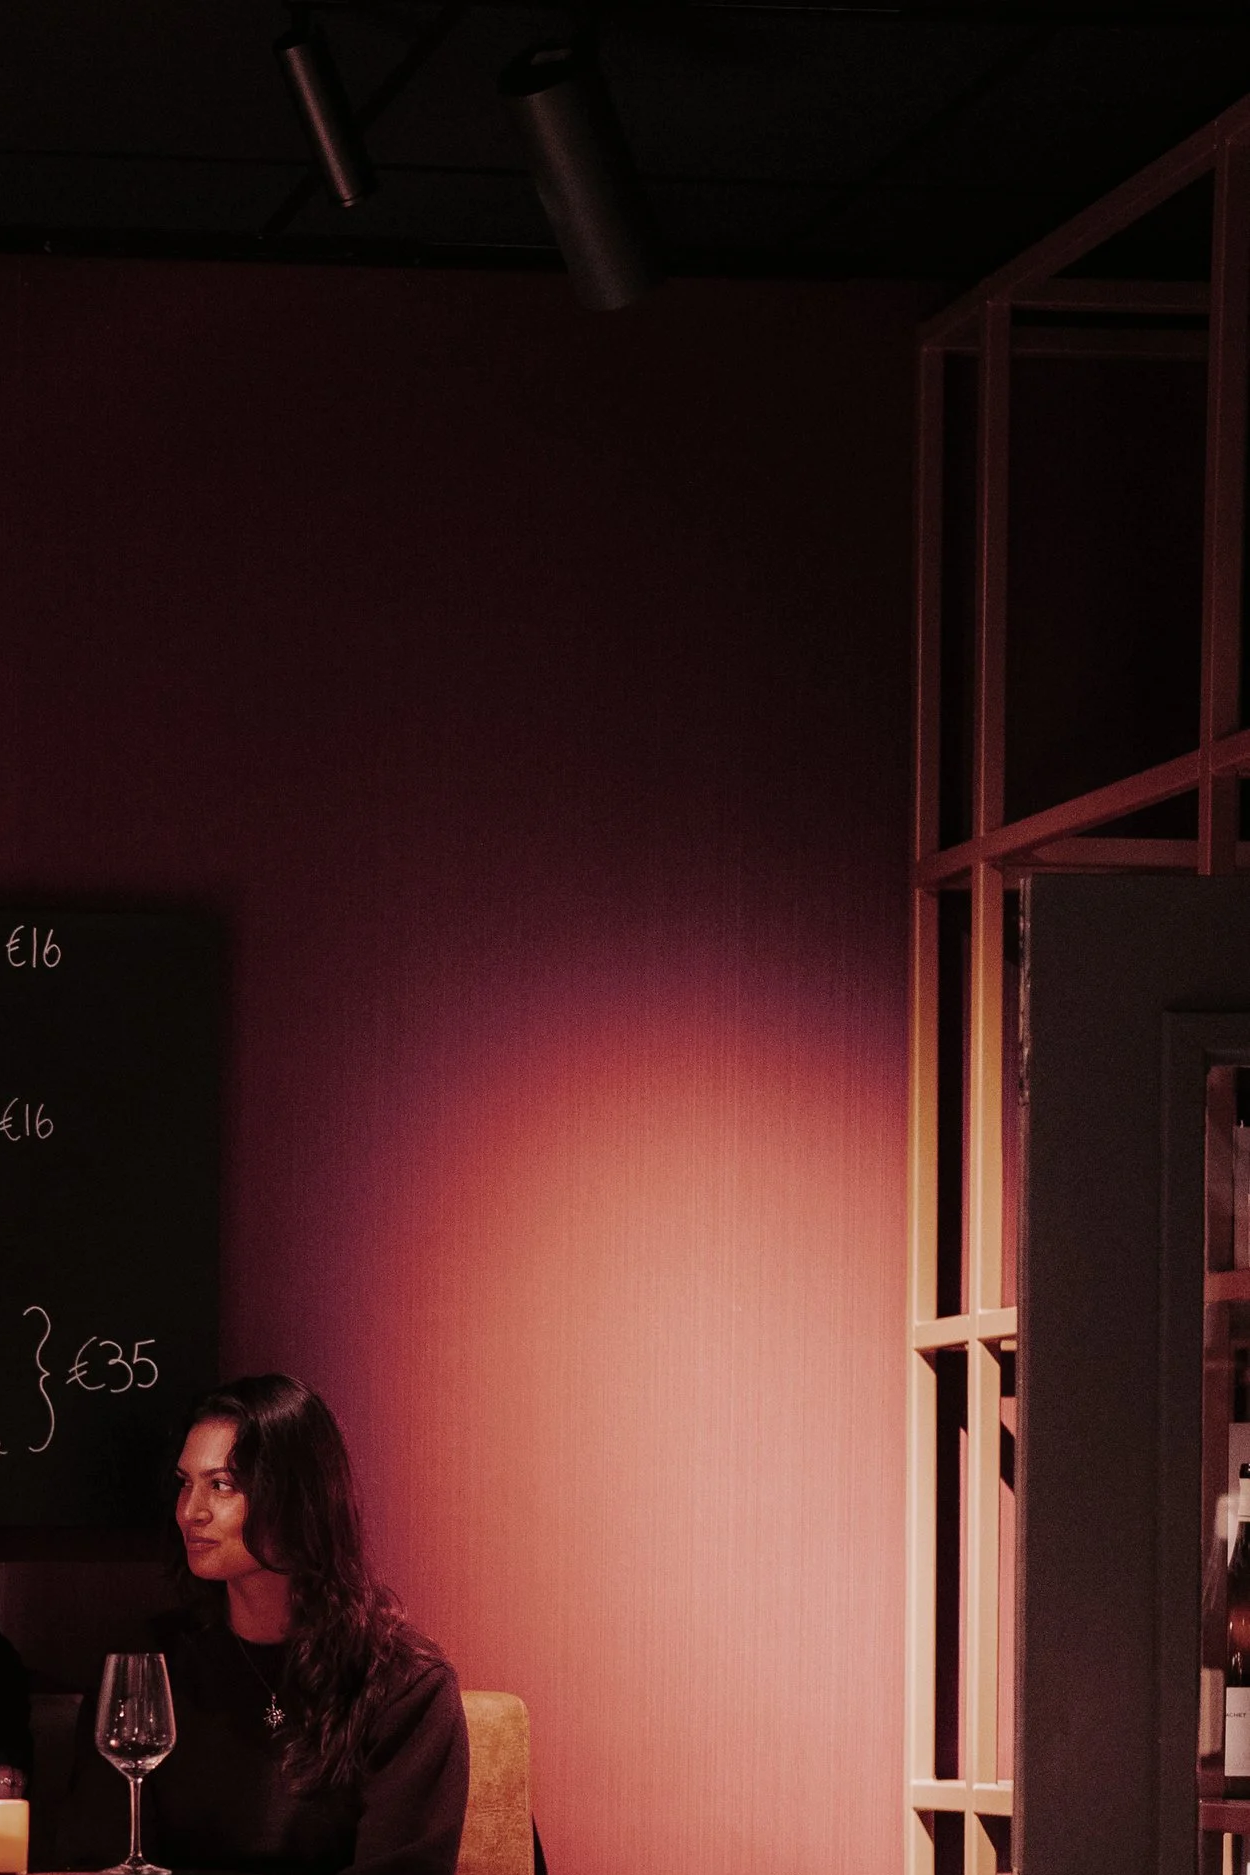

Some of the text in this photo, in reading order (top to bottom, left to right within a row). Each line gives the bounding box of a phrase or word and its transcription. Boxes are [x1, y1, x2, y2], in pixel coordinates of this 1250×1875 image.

[6, 926, 61, 967] €16
[0, 1098, 53, 1141] €16
[66, 1337, 158, 1392] €35
